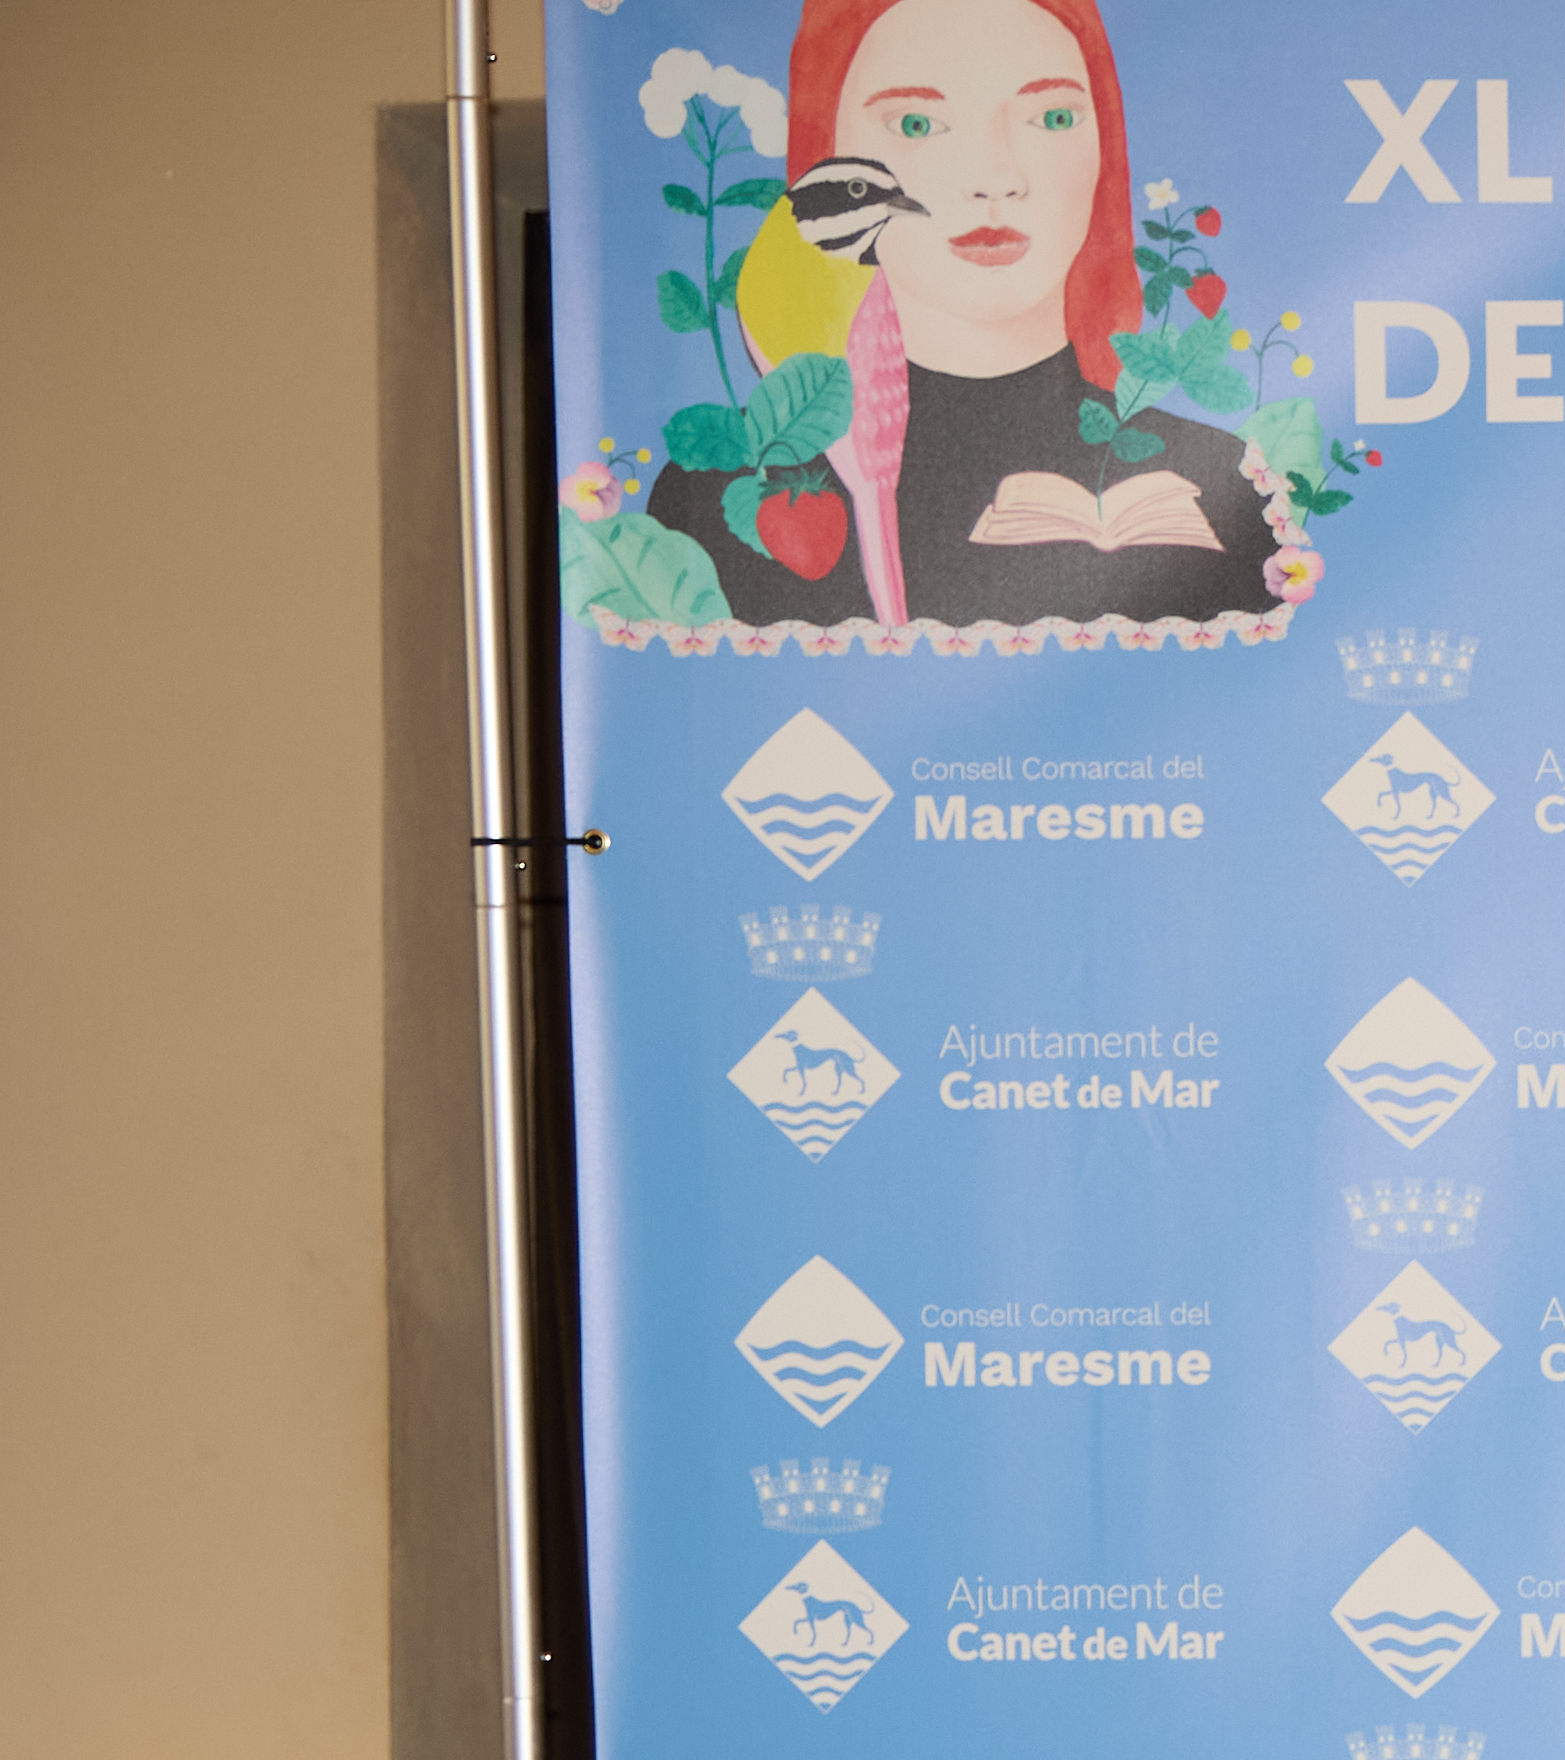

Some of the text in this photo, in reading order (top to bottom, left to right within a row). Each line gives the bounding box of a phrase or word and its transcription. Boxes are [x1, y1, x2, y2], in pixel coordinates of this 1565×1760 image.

[912, 756, 1204, 781] Consell Comarcal del
[914, 794, 1205, 841] Maresme
[939, 1022, 1218, 1067] Ajuntament de
[939, 1069, 1221, 1111] Canet de Mar
[922, 1303, 1211, 1328] Consell Comarcal del
[924, 1341, 1212, 1388] Maresme
[947, 1574, 1223, 1619] Ajuntament de
[946, 1621, 1225, 1662] Canet de Mar
